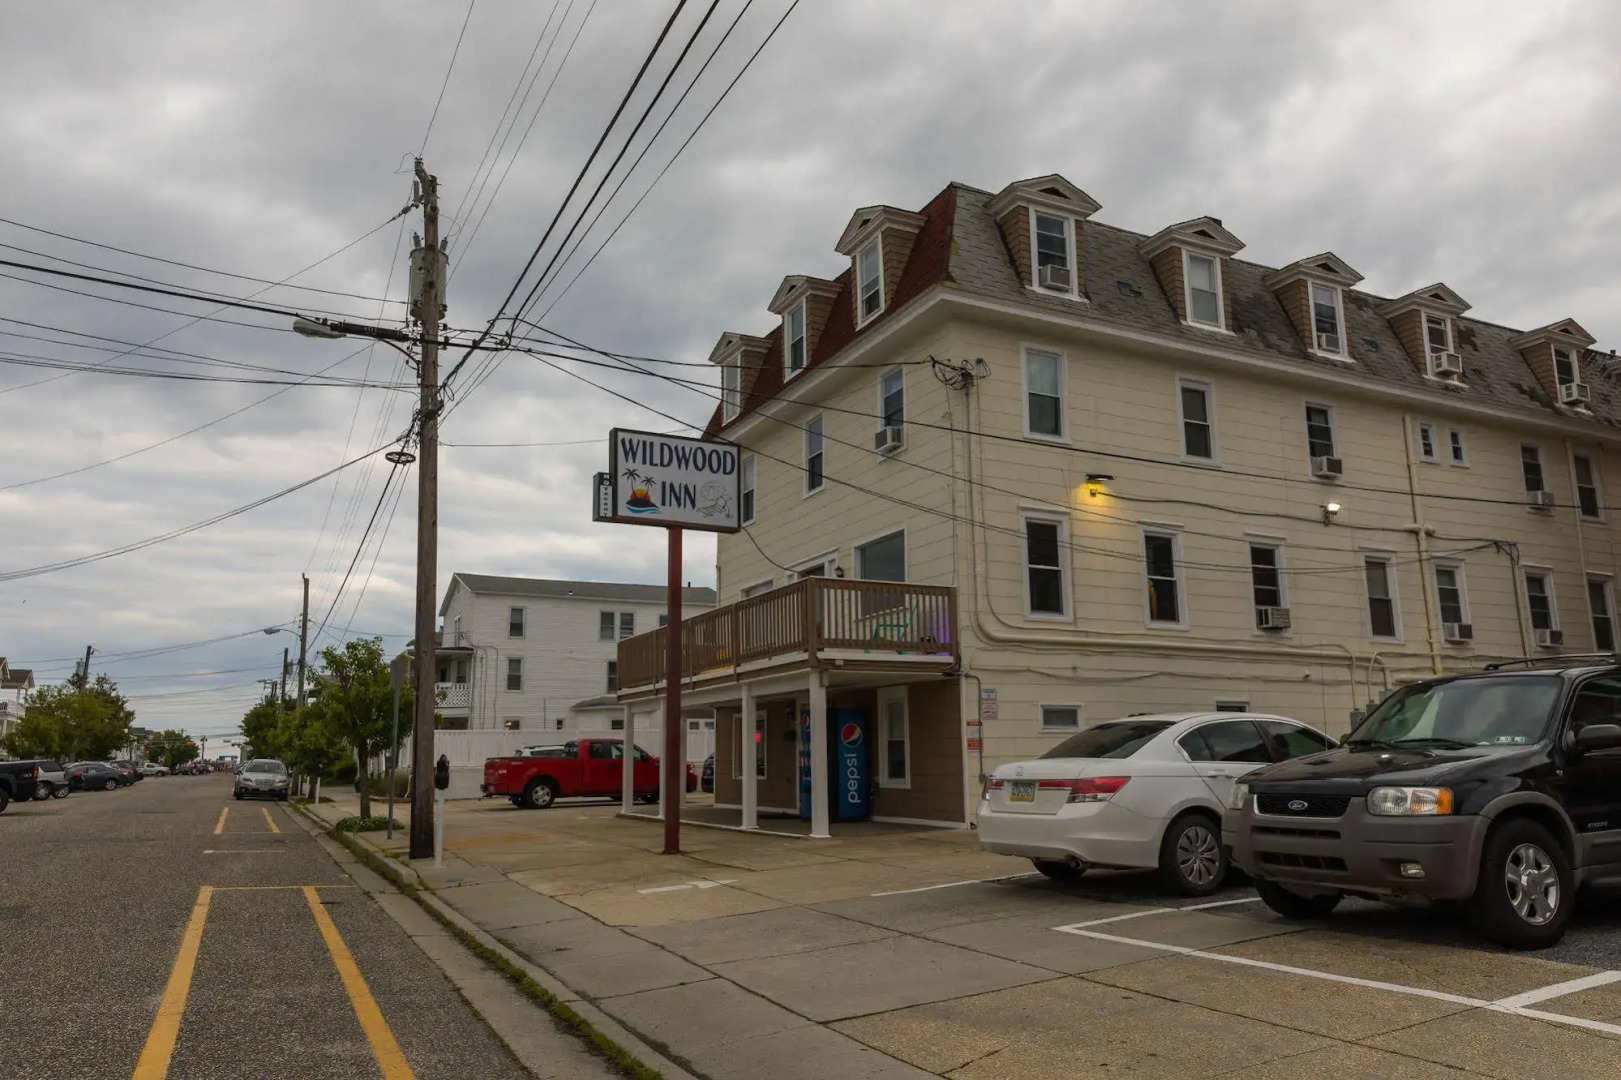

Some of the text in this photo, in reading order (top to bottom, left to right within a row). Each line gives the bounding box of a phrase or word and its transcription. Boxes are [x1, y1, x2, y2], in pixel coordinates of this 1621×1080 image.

[620, 437, 736, 475] WILDWOOD
[661, 481, 696, 509] INN
[844, 753, 862, 803] pepsi
